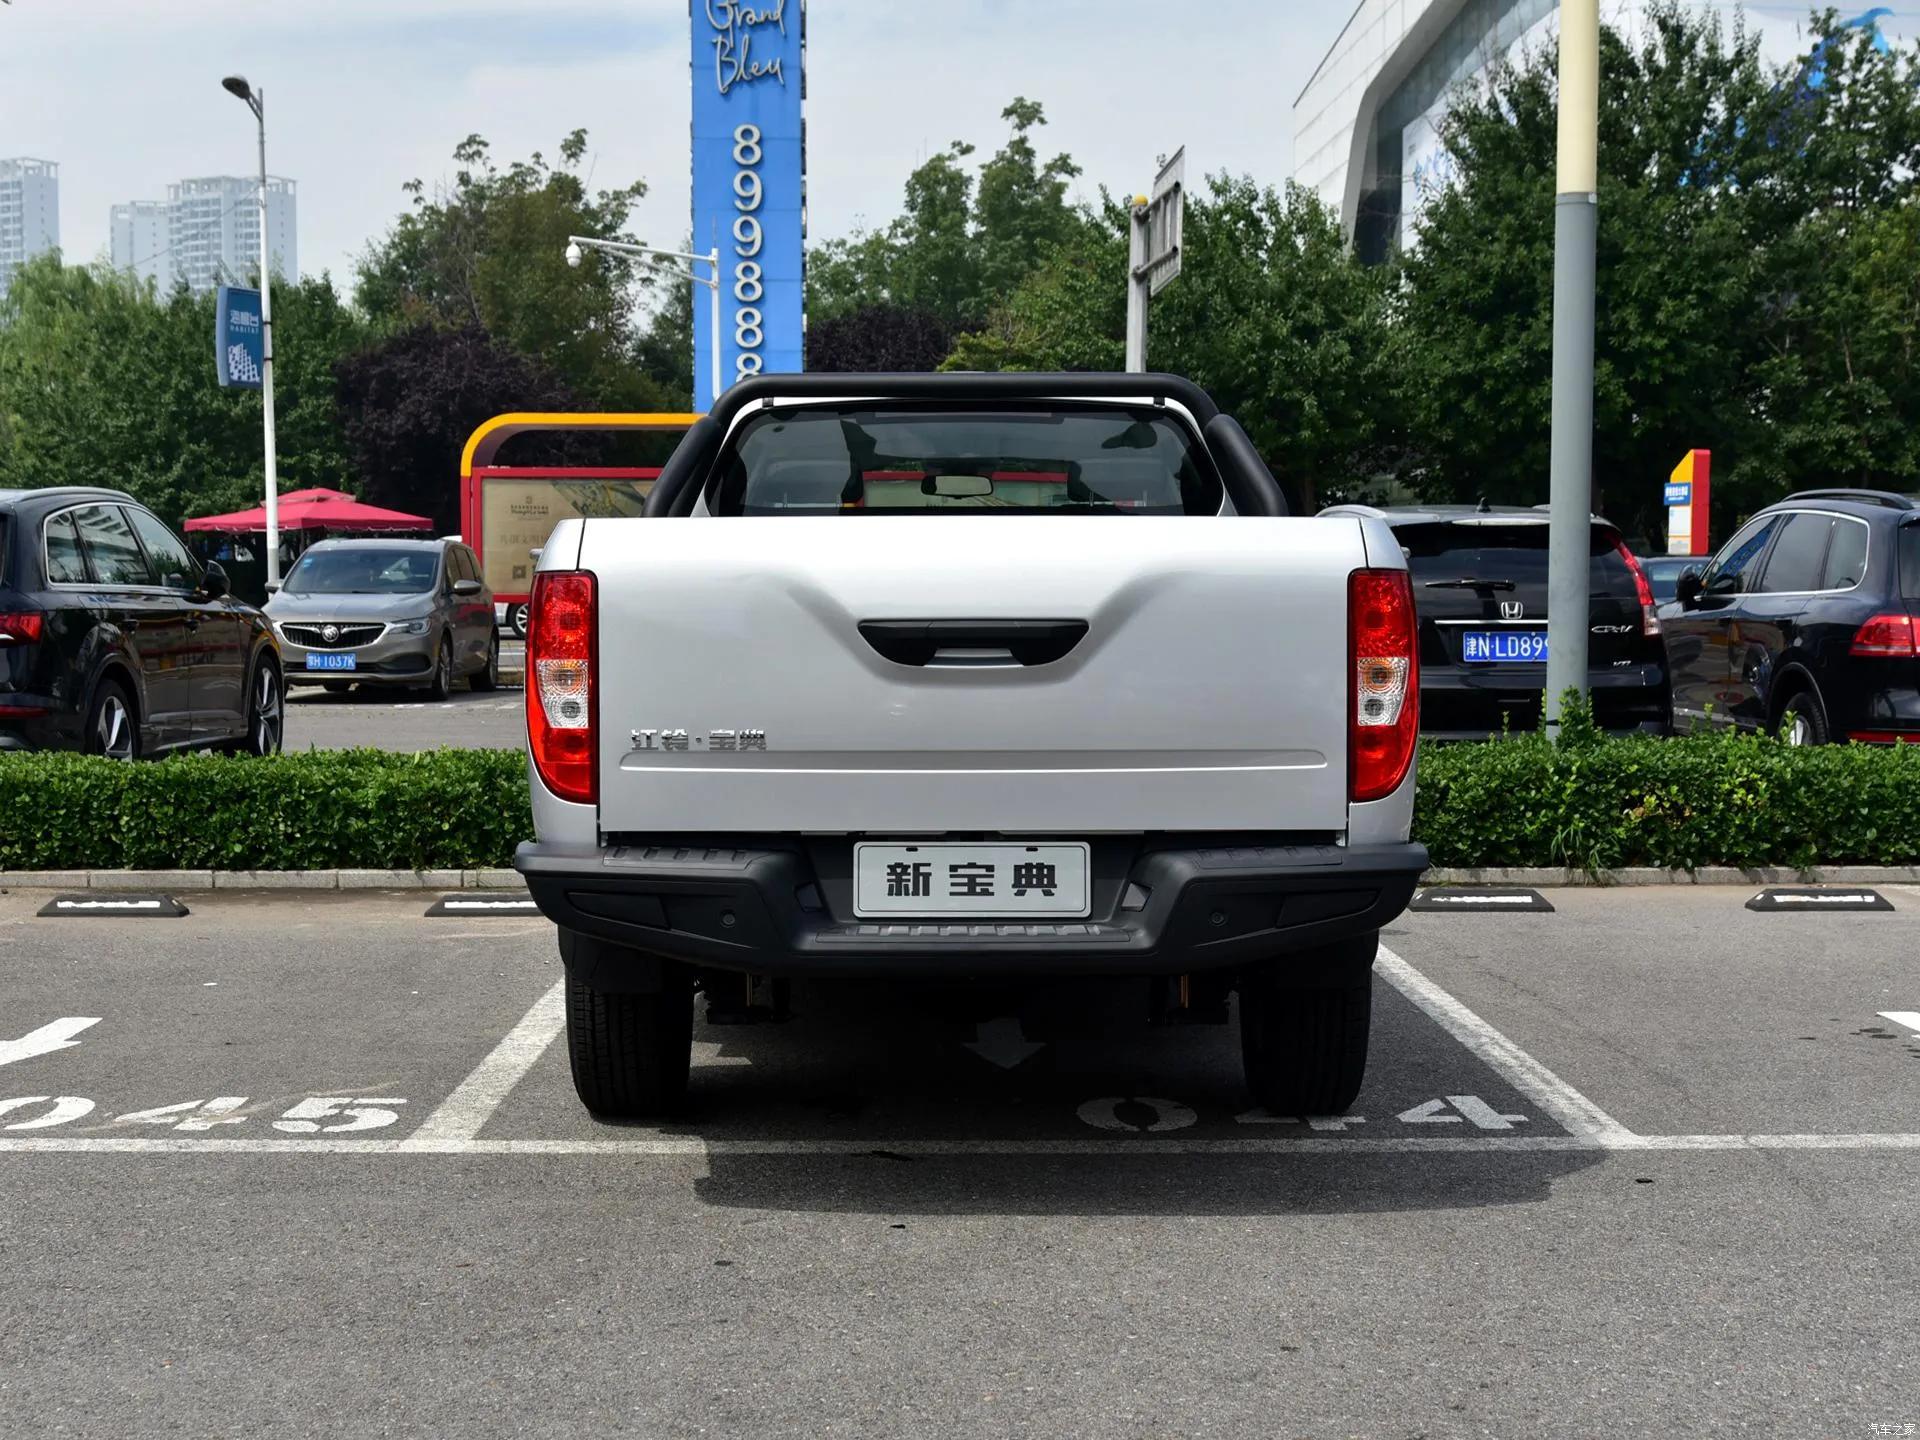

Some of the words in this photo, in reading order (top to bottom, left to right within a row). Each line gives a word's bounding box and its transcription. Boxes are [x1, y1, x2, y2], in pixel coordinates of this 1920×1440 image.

[705, 0, 785, 48] Grand
[712, 34, 785, 93] Bleu
[1465, 636, 1548, 657] 津N·LD89
[1591, 625, 1634, 634] CR-V
[886, 862, 1058, 897] 新宝典
